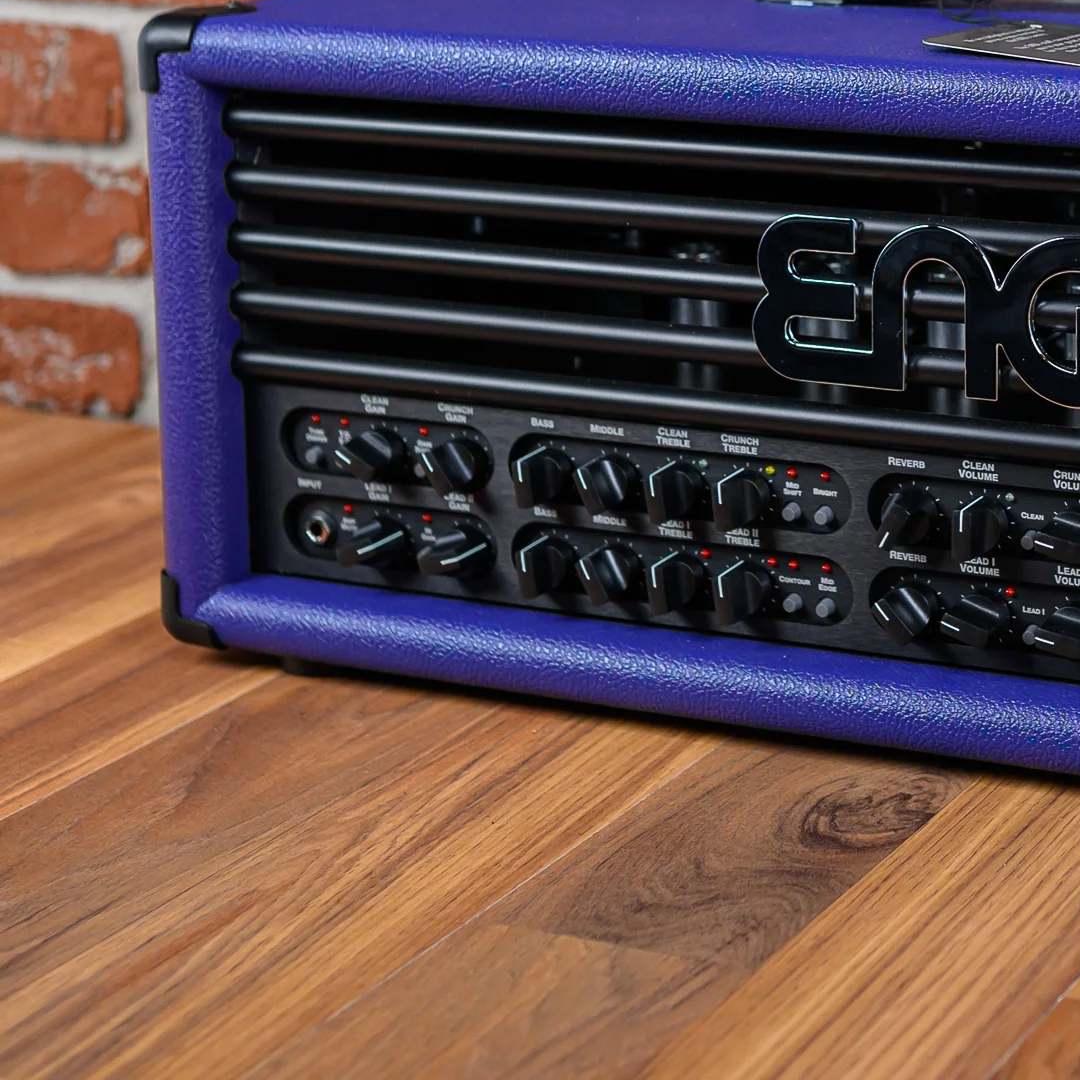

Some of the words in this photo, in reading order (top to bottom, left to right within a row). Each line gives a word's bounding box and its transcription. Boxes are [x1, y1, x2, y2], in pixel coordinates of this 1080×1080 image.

[360, 393, 389, 406] CLEAN
[364, 403, 386, 415] GAIN
[437, 402, 474, 415] CRUNCH
[445, 412, 467, 424] GAIN
[531, 417, 554, 429] BASS
[590, 424, 624, 437] MIDDLE
[658, 427, 688, 439] CLEAN
[656, 435, 691, 449] TREBLE
[720, 433, 759, 447] CRUNCH
[722, 443, 758, 455] TREBLE
[888, 456, 926, 469] REVERB
[962, 460, 995, 472] CLEAN
[958, 469, 999, 482] VOLUME
[298, 477, 322, 490] INPUT
[368, 491, 390, 502] GAIN
[812, 487, 838, 497] BRIGHT
[448, 500, 470, 512] GAIN
[533, 506, 557, 518] BASS
[593, 515, 627, 527] MIDDLE
[1020, 511, 1045, 521] CLEAN
[658, 526, 693, 539] TREBLE
[752, 529, 759, 538] II
[724, 534, 760, 547] TREBLE
[889, 550, 927, 563] REVERB
[960, 563, 1000, 577] VOLUME
[778, 575, 811, 586] CONTOUR
[1022, 606, 1040, 615] LEAD
